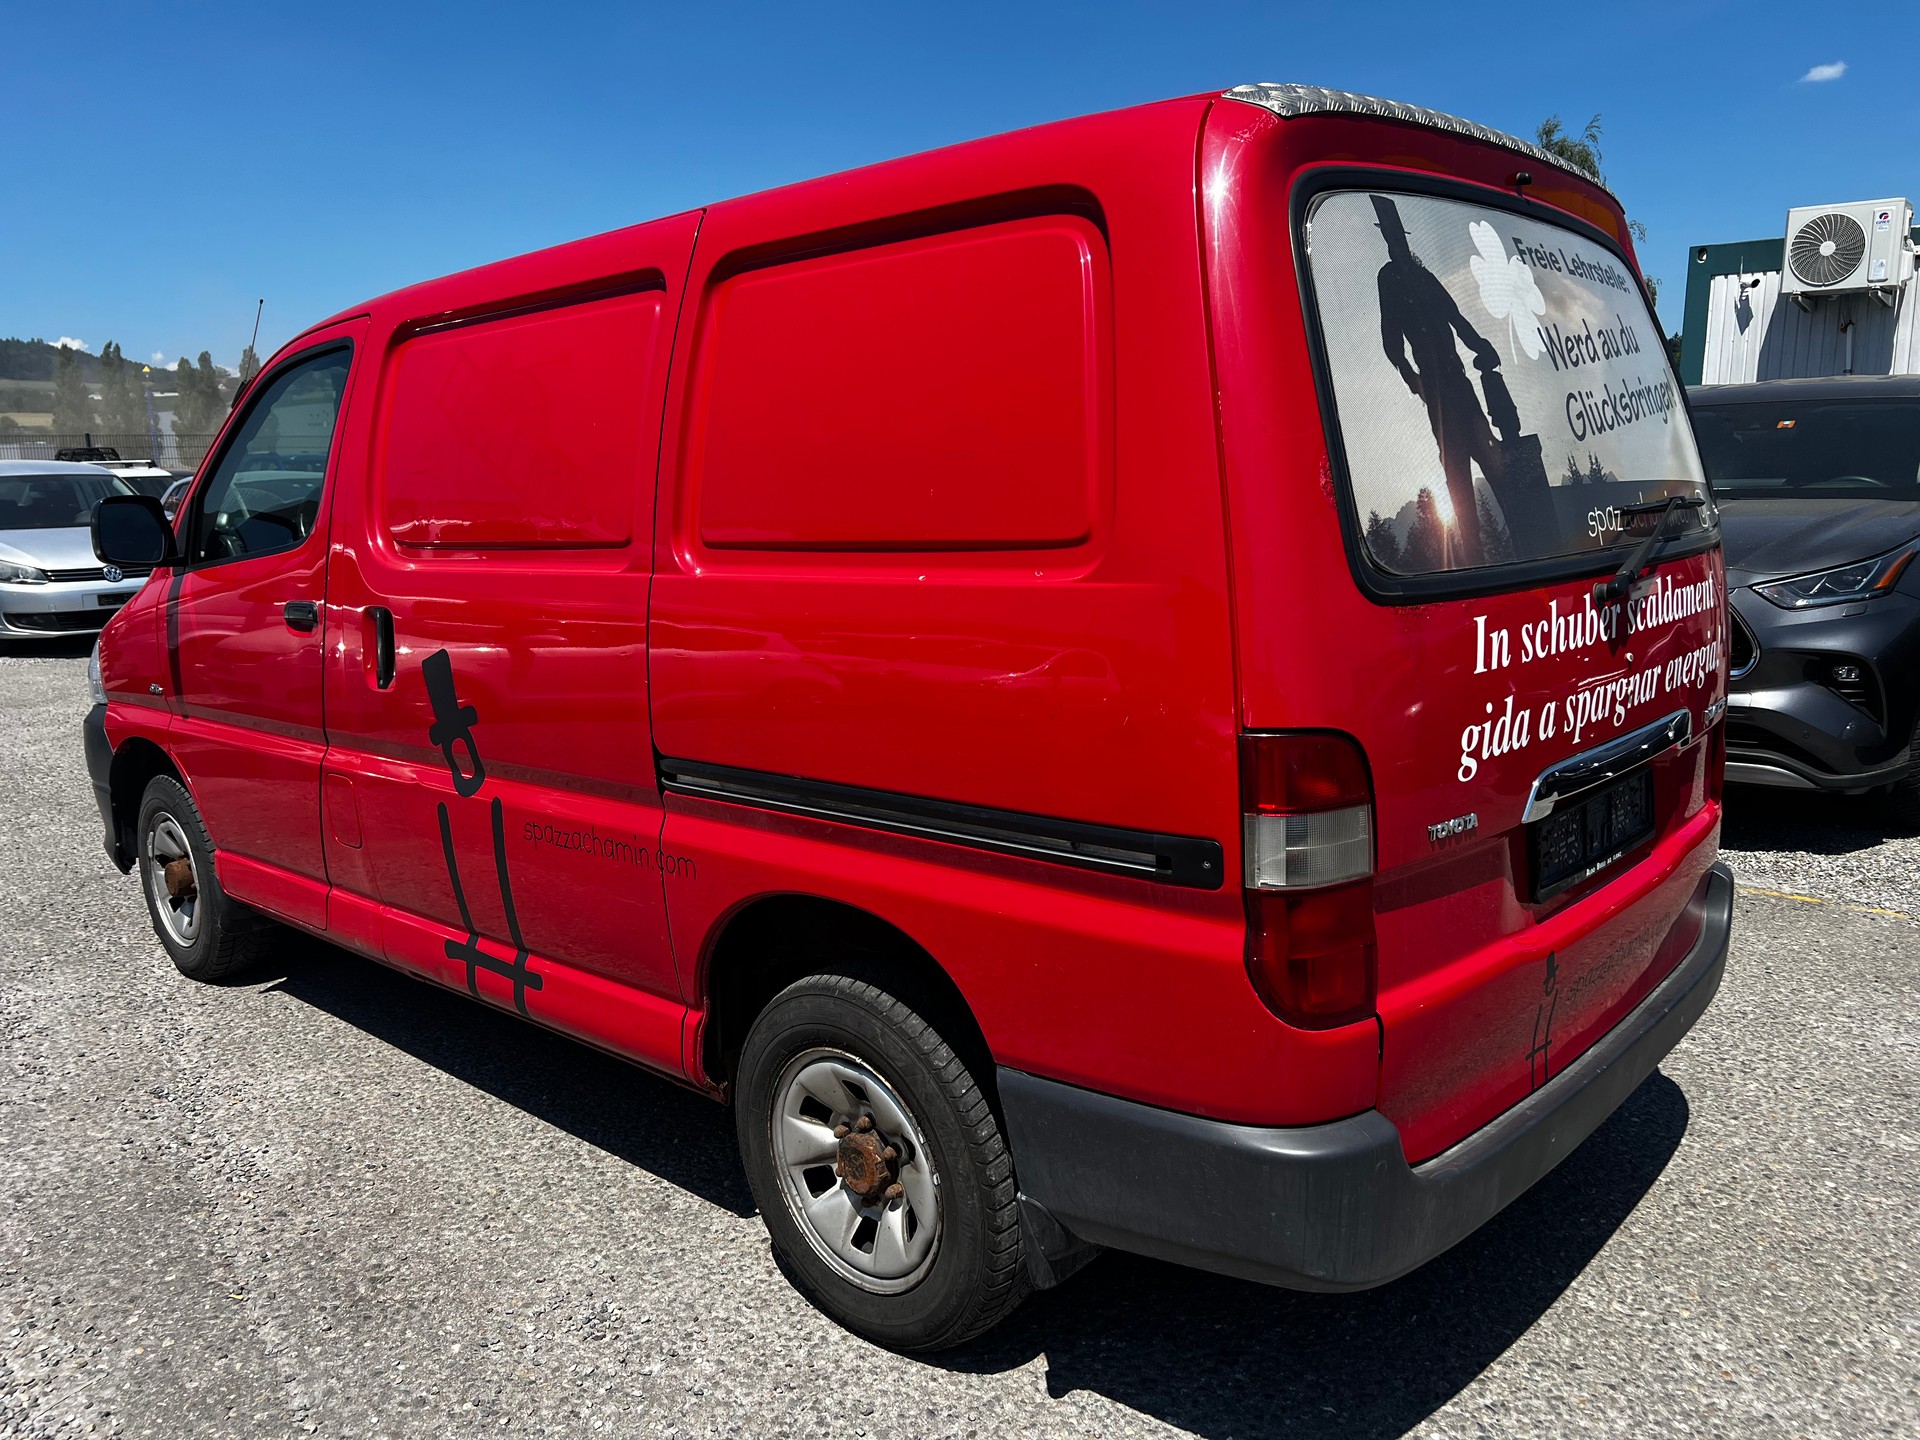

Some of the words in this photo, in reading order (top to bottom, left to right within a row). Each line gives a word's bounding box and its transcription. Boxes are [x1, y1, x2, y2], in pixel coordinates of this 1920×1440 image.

[1512, 236, 1562, 273] Freie
[1537, 318, 1600, 372] Werd
[1597, 327, 1623, 361] au
[1616, 313, 1641, 356] du
[1473, 615, 1511, 674] In
[1521, 592, 1621, 664] schuber
[1627, 571, 1714, 635] scaldament
[1457, 694, 1531, 782] gida
[1539, 701, 1557, 741] a
[1563, 664, 1662, 744] spargnar
[524, 821, 697, 880] spazzachamin.com
[1428, 812, 1479, 842] TOYOTA
